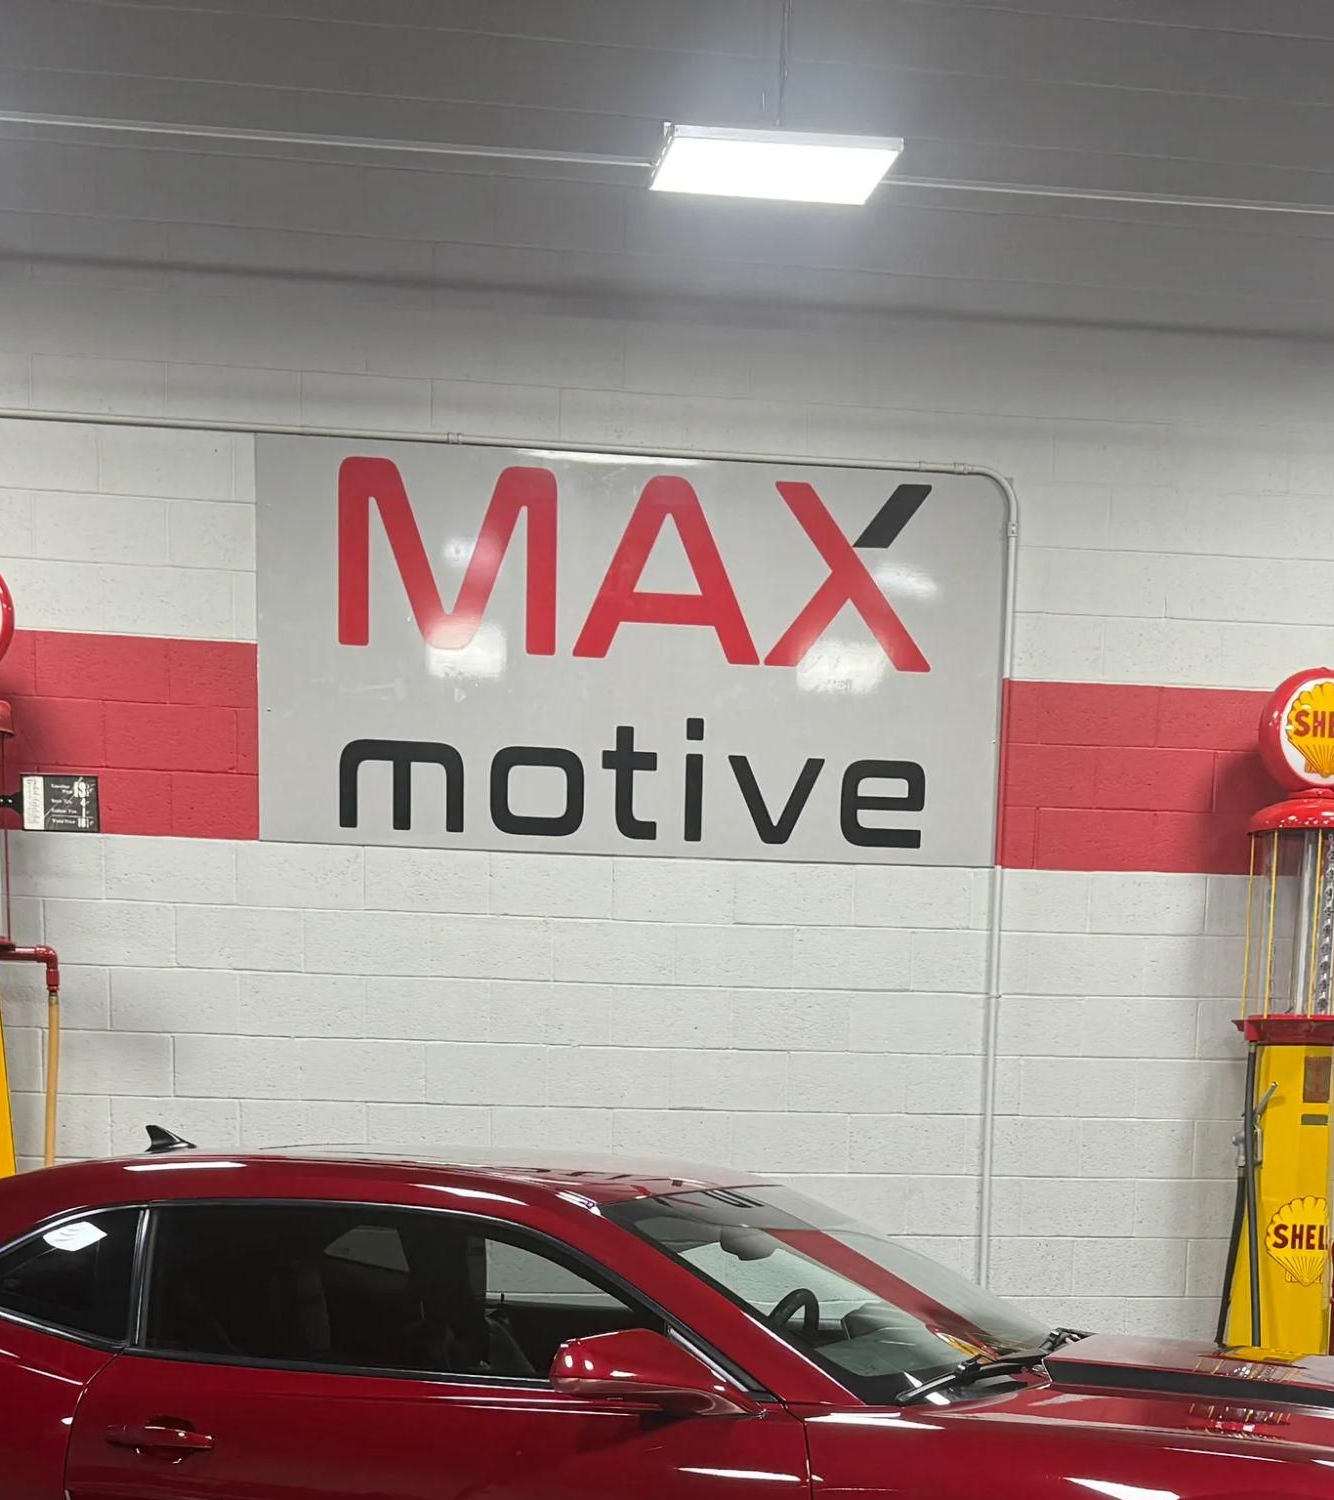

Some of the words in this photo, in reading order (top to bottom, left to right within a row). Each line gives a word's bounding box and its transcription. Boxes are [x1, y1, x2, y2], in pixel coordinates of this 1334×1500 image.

[337, 455, 933, 673] MAX
[337, 717, 926, 850] motive
[1272, 1223, 1329, 1251] SHEL
